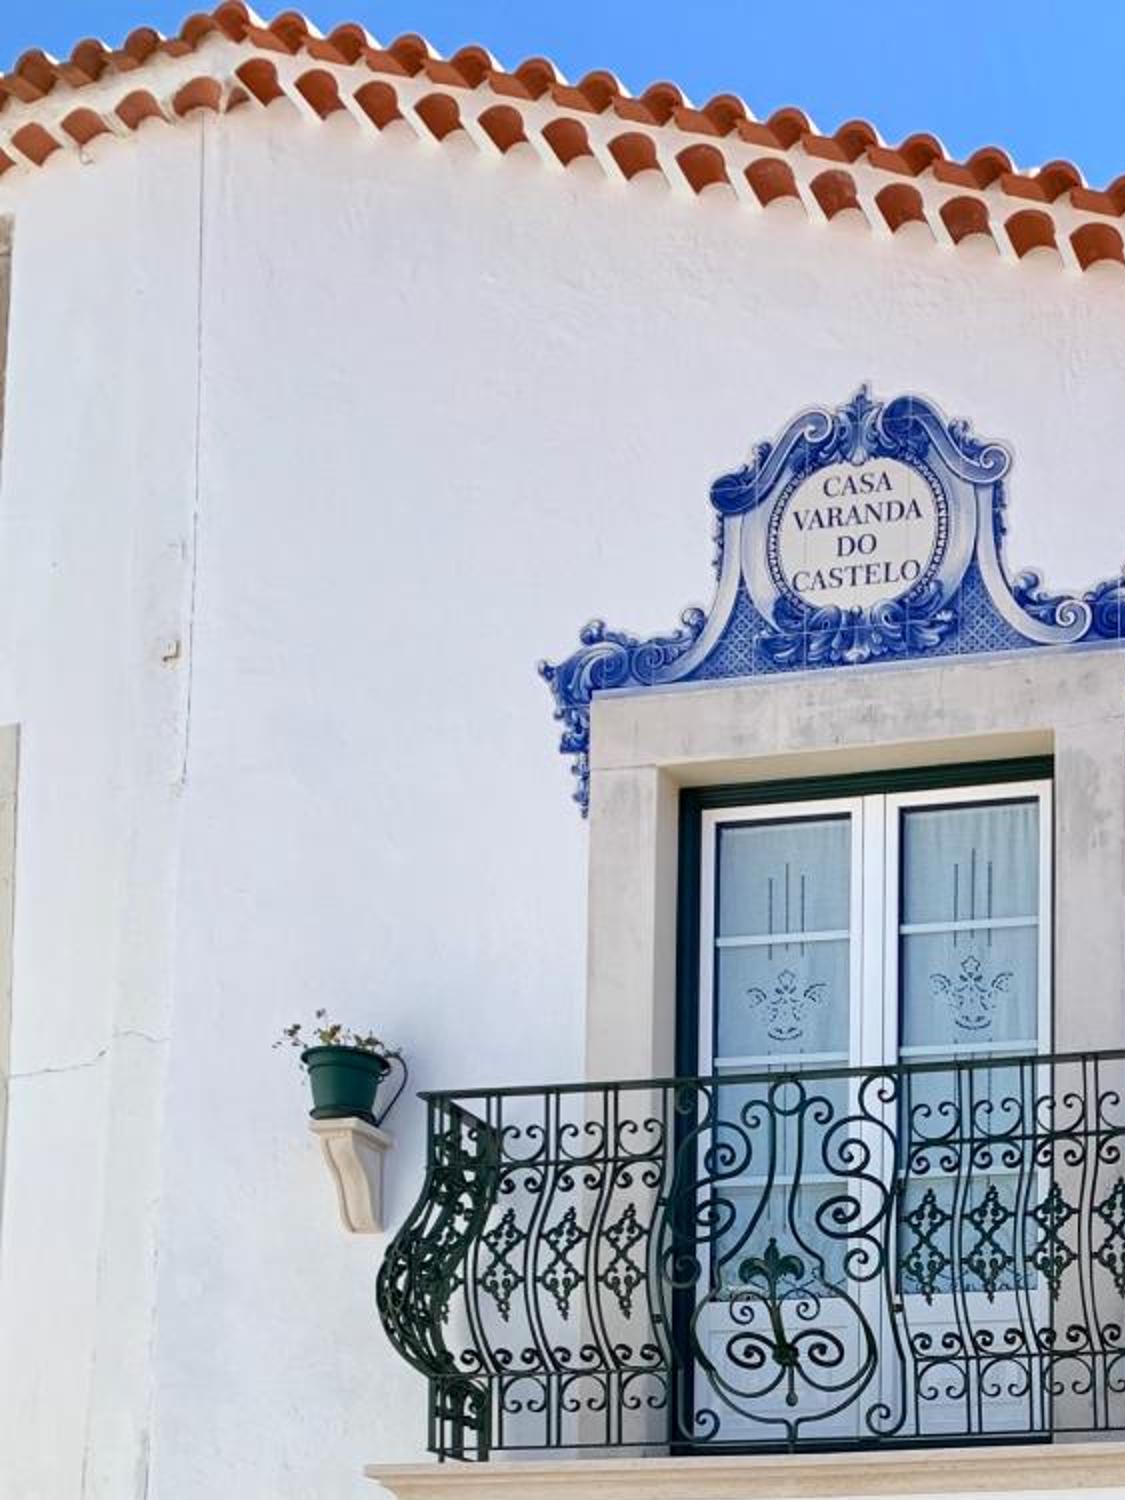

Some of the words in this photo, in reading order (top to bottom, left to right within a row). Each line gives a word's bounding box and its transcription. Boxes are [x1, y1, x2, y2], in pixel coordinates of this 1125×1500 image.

[823, 471, 892, 497] CASA
[793, 499, 922, 531] VARANDA
[837, 533, 877, 557] DO
[792, 560, 921, 593] CASTELO
